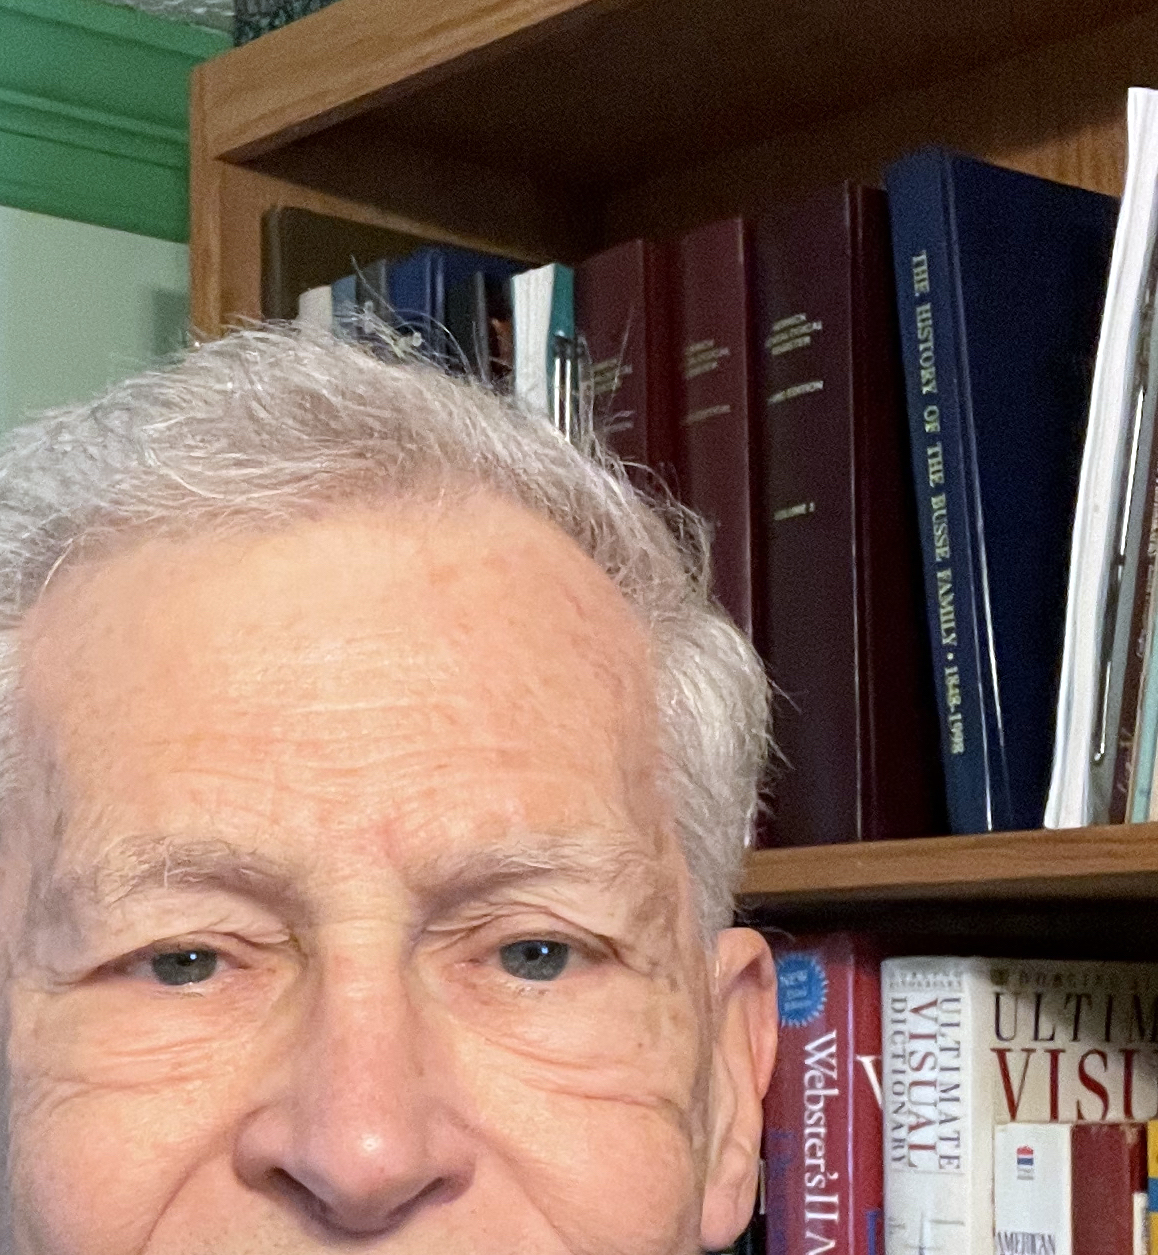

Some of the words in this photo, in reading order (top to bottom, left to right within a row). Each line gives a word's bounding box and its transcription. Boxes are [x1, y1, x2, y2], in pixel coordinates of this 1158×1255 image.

[912, 250, 930, 295] THE
[915, 302, 938, 395] HISTORY
[923, 404, 941, 433] OF
[927, 442, 945, 487] THE
[931, 493, 951, 562] BUSSE
[936, 567, 958, 647] FAMILY
[804, 1030, 840, 1188] Webster's
[891, 997, 908, 1162] DICTIONARY
[908, 998, 938, 1168] VISUAL
[938, 998, 961, 1169] ULTIMATE
[804, 1194, 840, 1222] II
